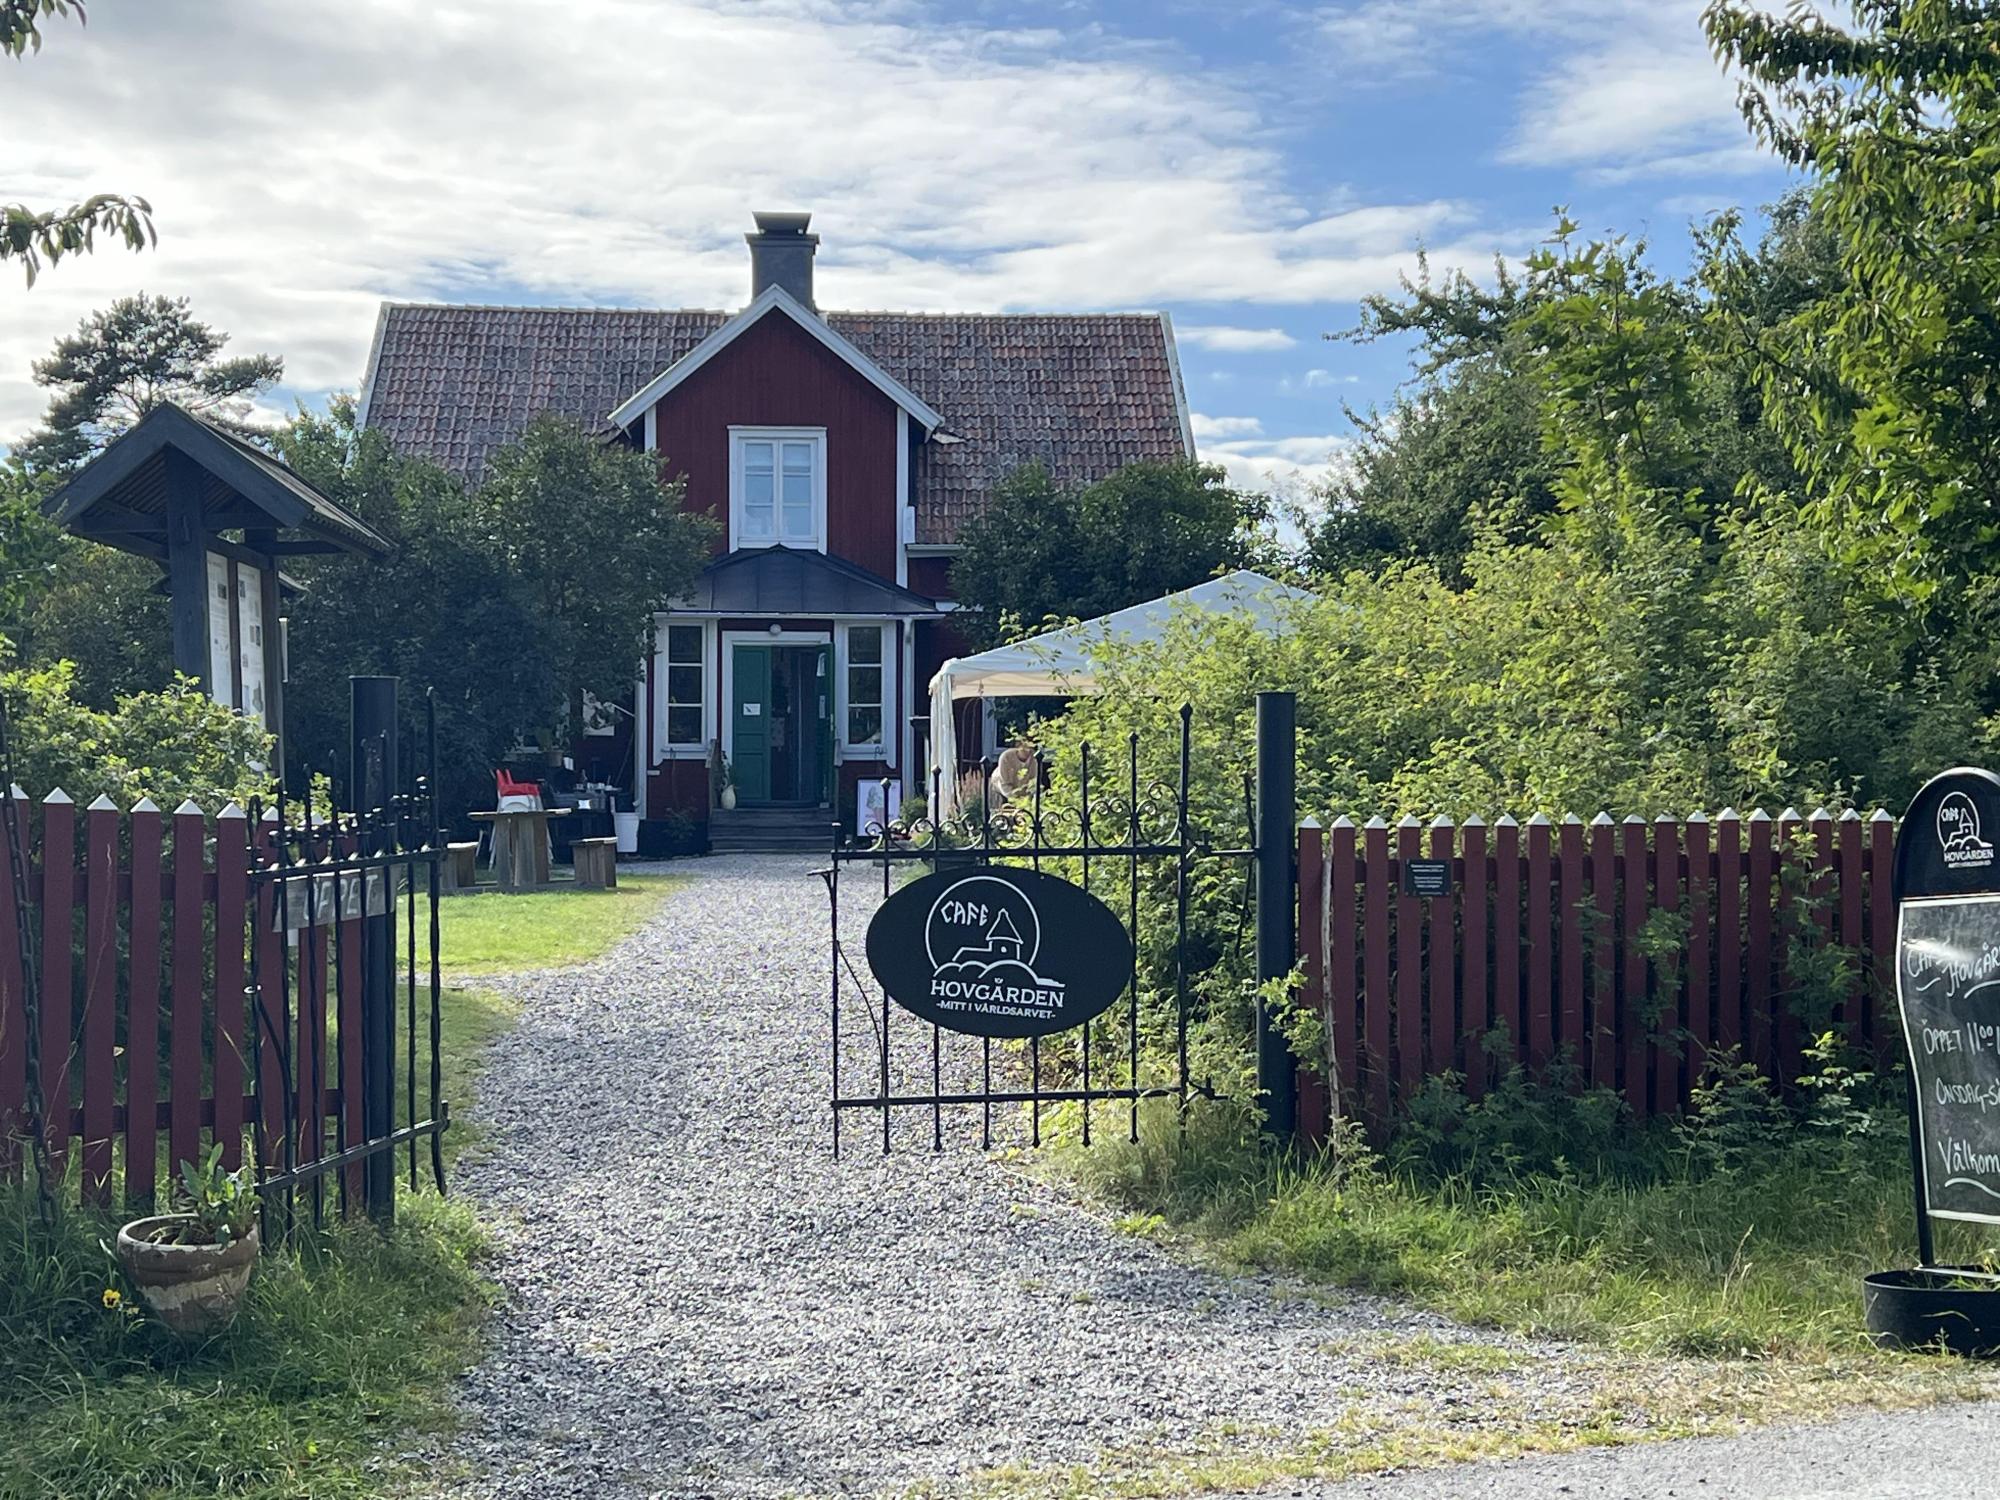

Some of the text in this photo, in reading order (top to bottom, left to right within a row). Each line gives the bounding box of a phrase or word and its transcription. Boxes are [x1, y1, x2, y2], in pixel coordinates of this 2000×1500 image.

[941, 901, 989, 926] CAFE
[1942, 942, 2000, 997] HOVGÅR
[930, 978, 1065, 1008] HOVGÅRDEN
[1921, 1019, 1963, 1055] ÖPPET
